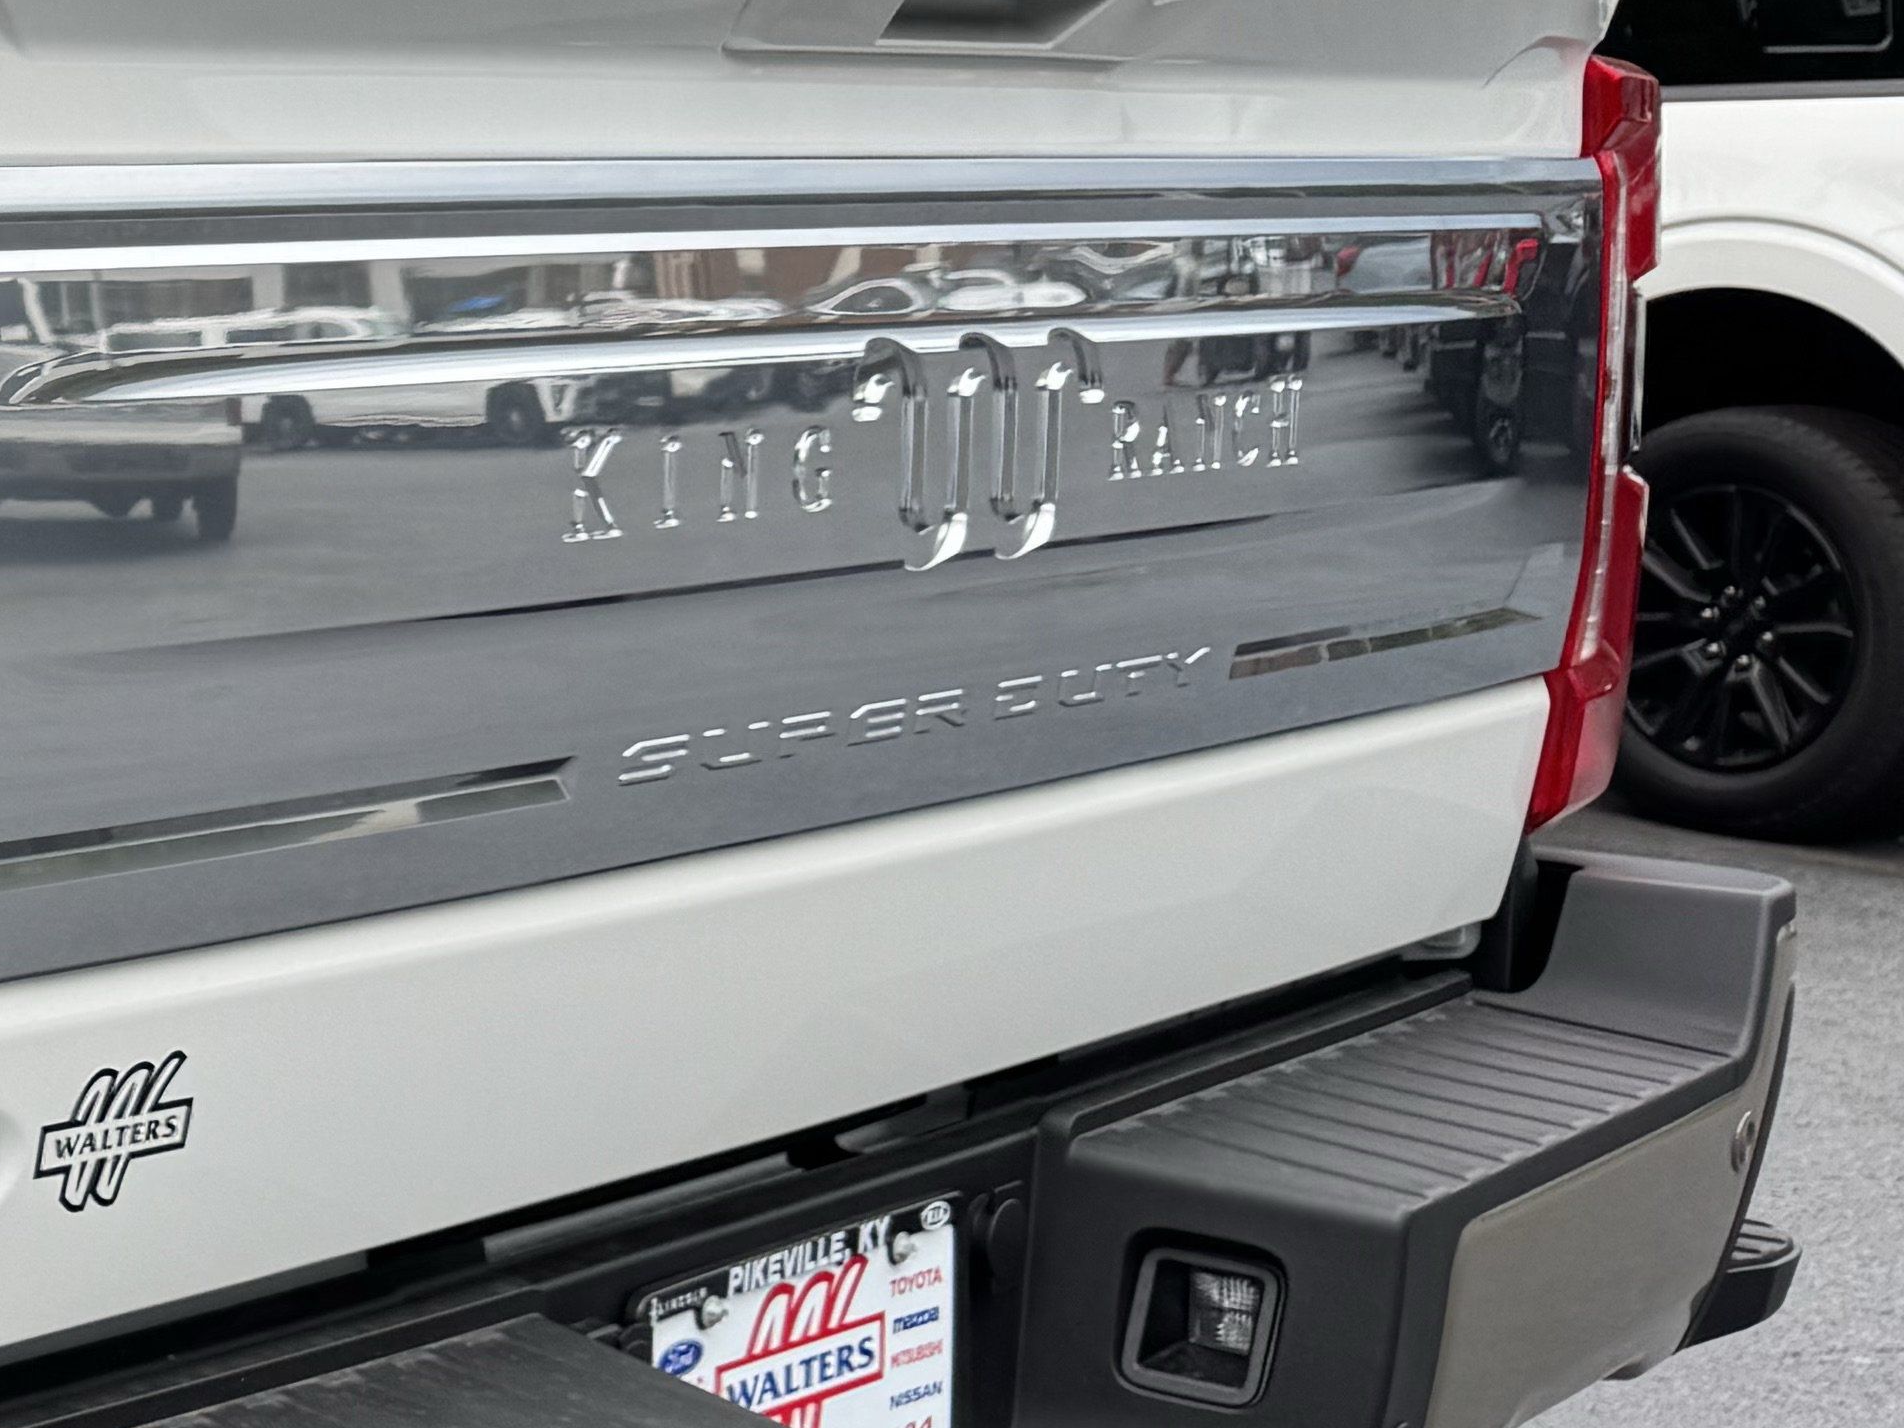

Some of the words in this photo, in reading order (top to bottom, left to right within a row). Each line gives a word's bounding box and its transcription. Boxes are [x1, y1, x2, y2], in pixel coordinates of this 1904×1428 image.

[560, 423, 835, 544] KING
[1106, 373, 1304, 482] RANCH
[617, 685, 966, 787] SUPER
[992, 644, 1212, 721] DUTY
[54, 1113, 179, 1160] WALTERS
[727, 1230, 852, 1299] PIKEVILLE,
[856, 1214, 892, 1256] KY
[889, 1266, 943, 1298] TOYOTA
[726, 1336, 875, 1410] WALTERS
[889, 1380, 944, 1410] NISSAN
